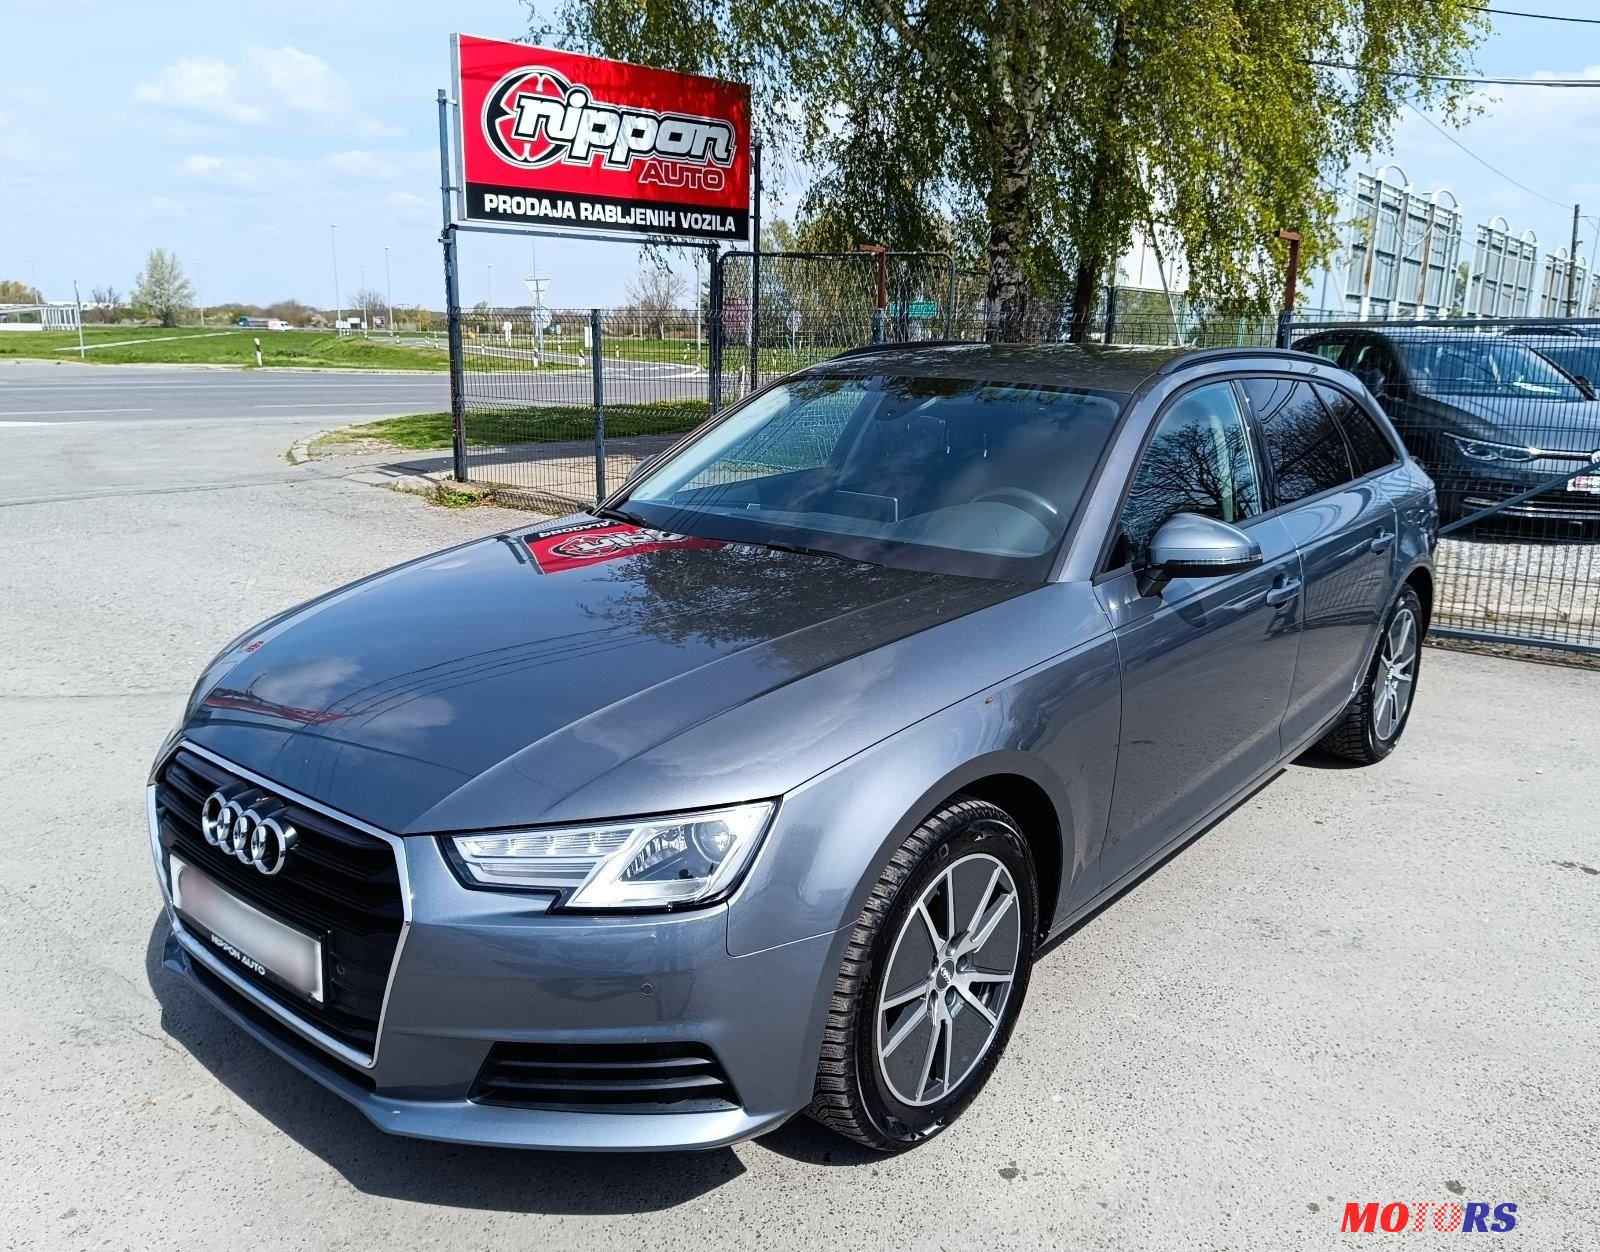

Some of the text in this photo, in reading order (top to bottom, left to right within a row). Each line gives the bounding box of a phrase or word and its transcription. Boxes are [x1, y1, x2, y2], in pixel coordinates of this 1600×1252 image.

[513, 88, 735, 168] nippon
[639, 162, 726, 191] AUTO
[484, 193, 736, 232] PRODAJA RABLJENIH VOZILA
[211, 934, 266, 976] NIPPON AUTO
